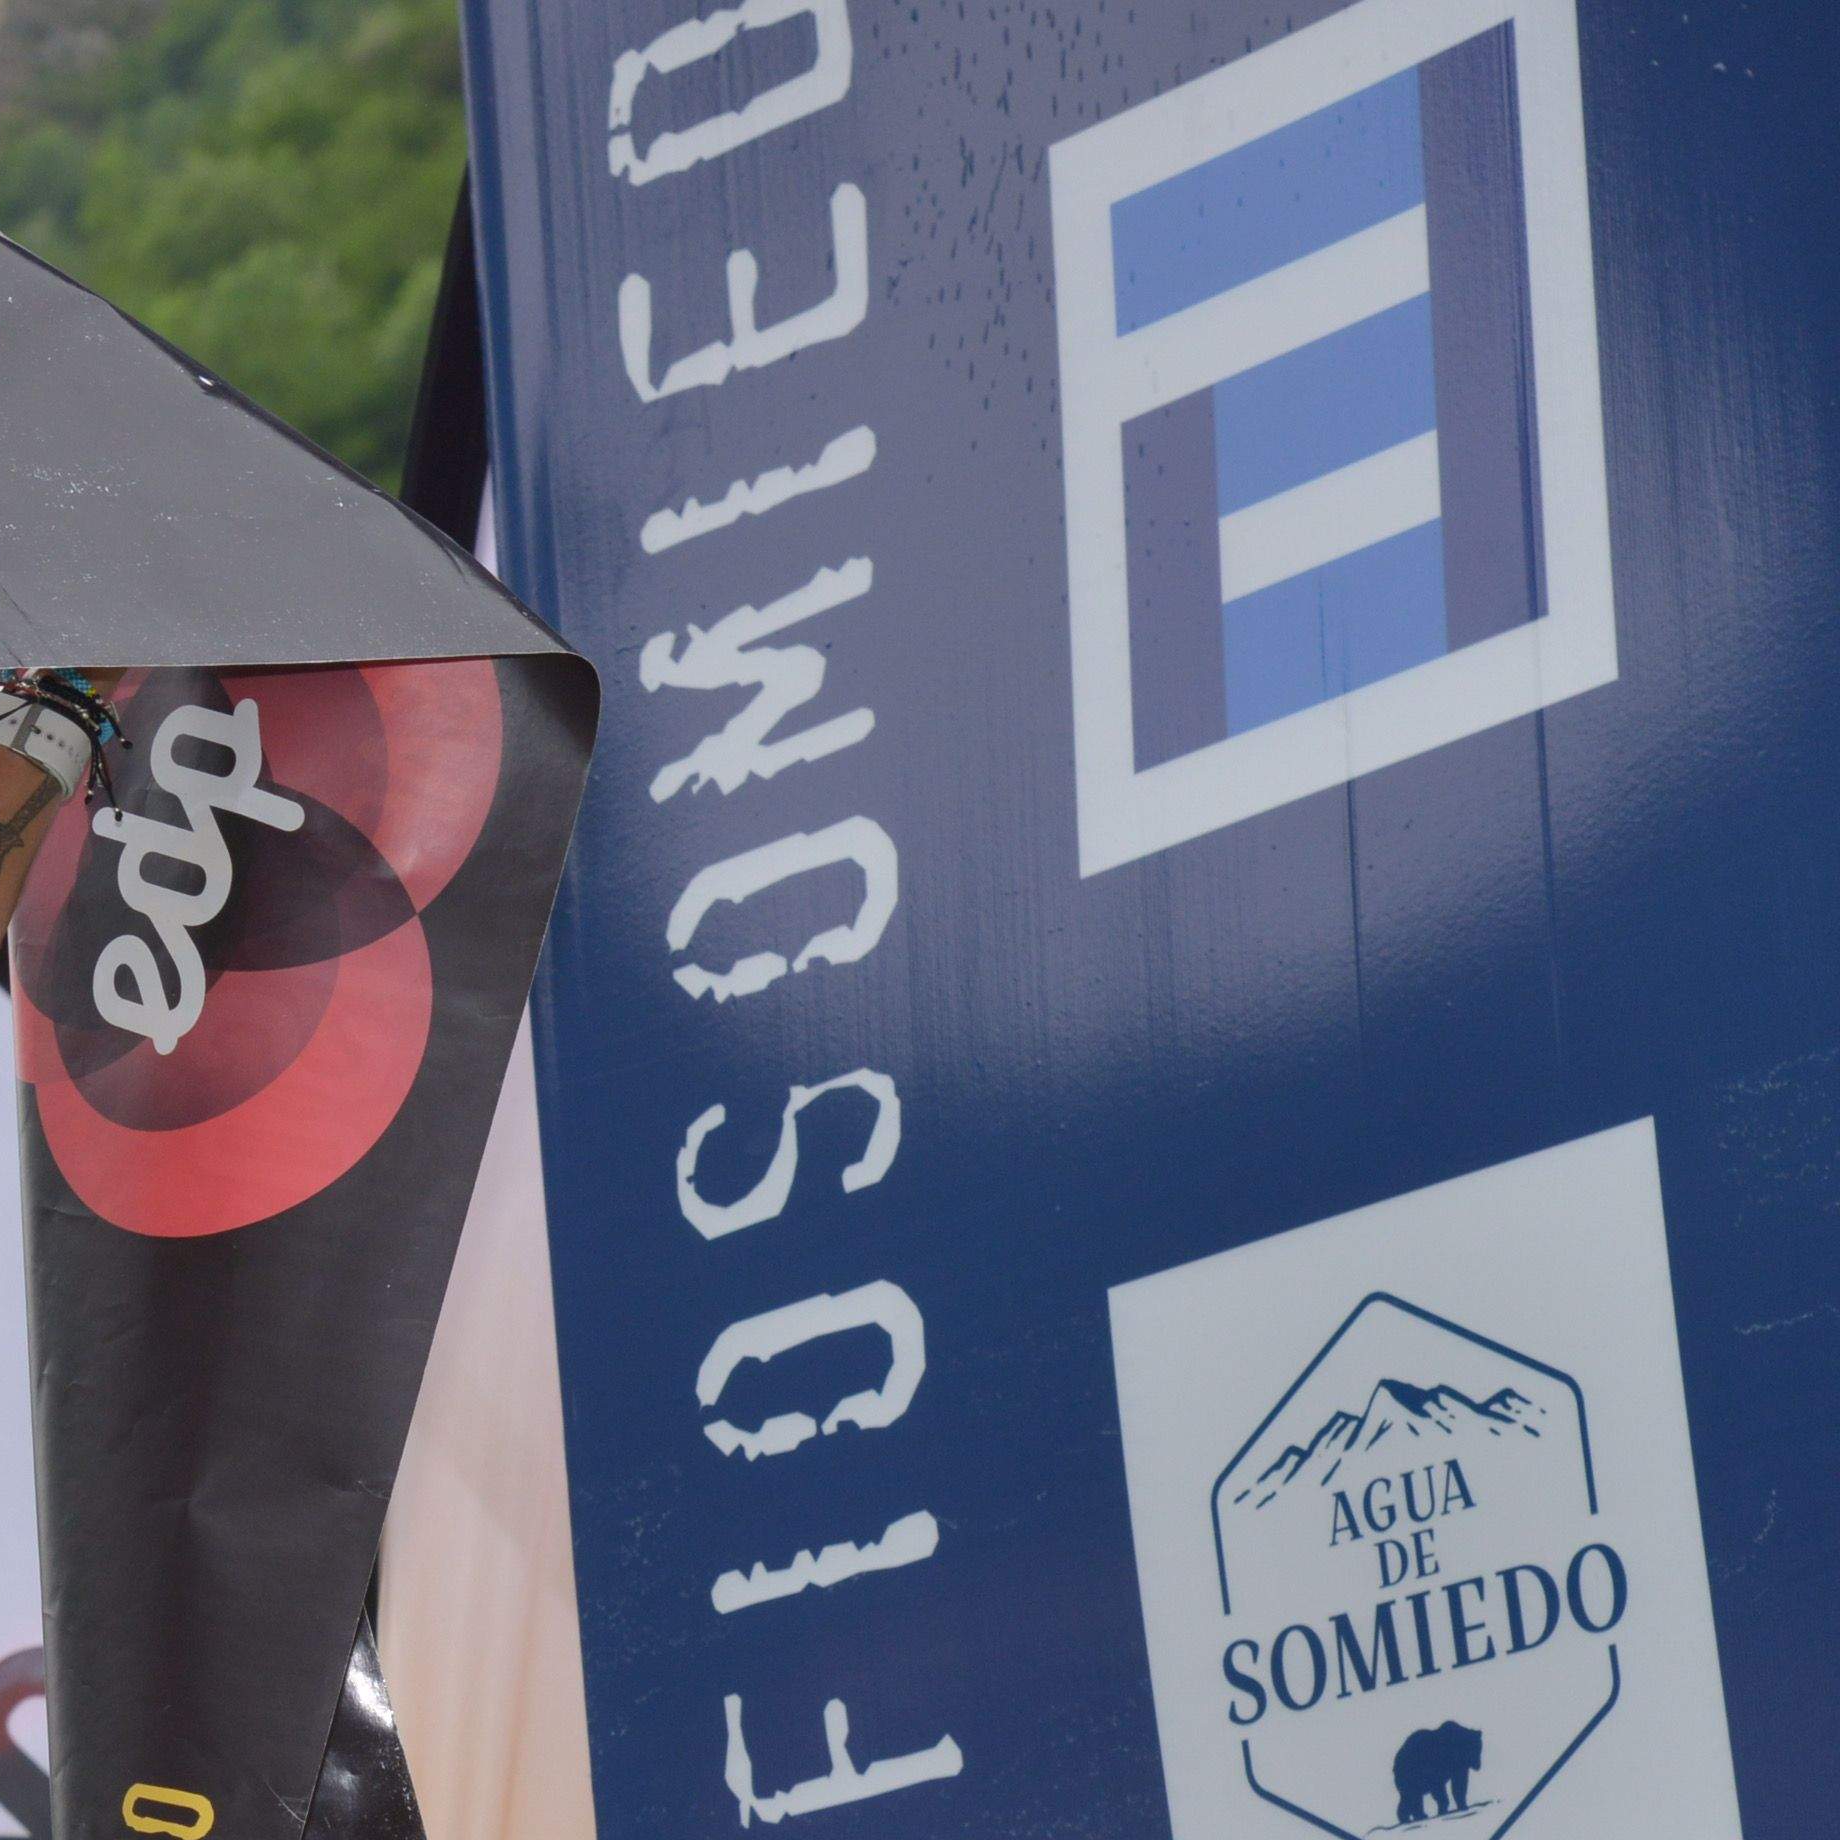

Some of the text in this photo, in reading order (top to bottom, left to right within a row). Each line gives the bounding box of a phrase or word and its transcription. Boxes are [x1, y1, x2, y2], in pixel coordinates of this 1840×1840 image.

[92, 697, 306, 1056] edp
[1327, 1457, 1478, 1547] AGUA
[1375, 1527, 1442, 1589] DE
[1220, 1541, 1630, 1727] SOMIEDO
